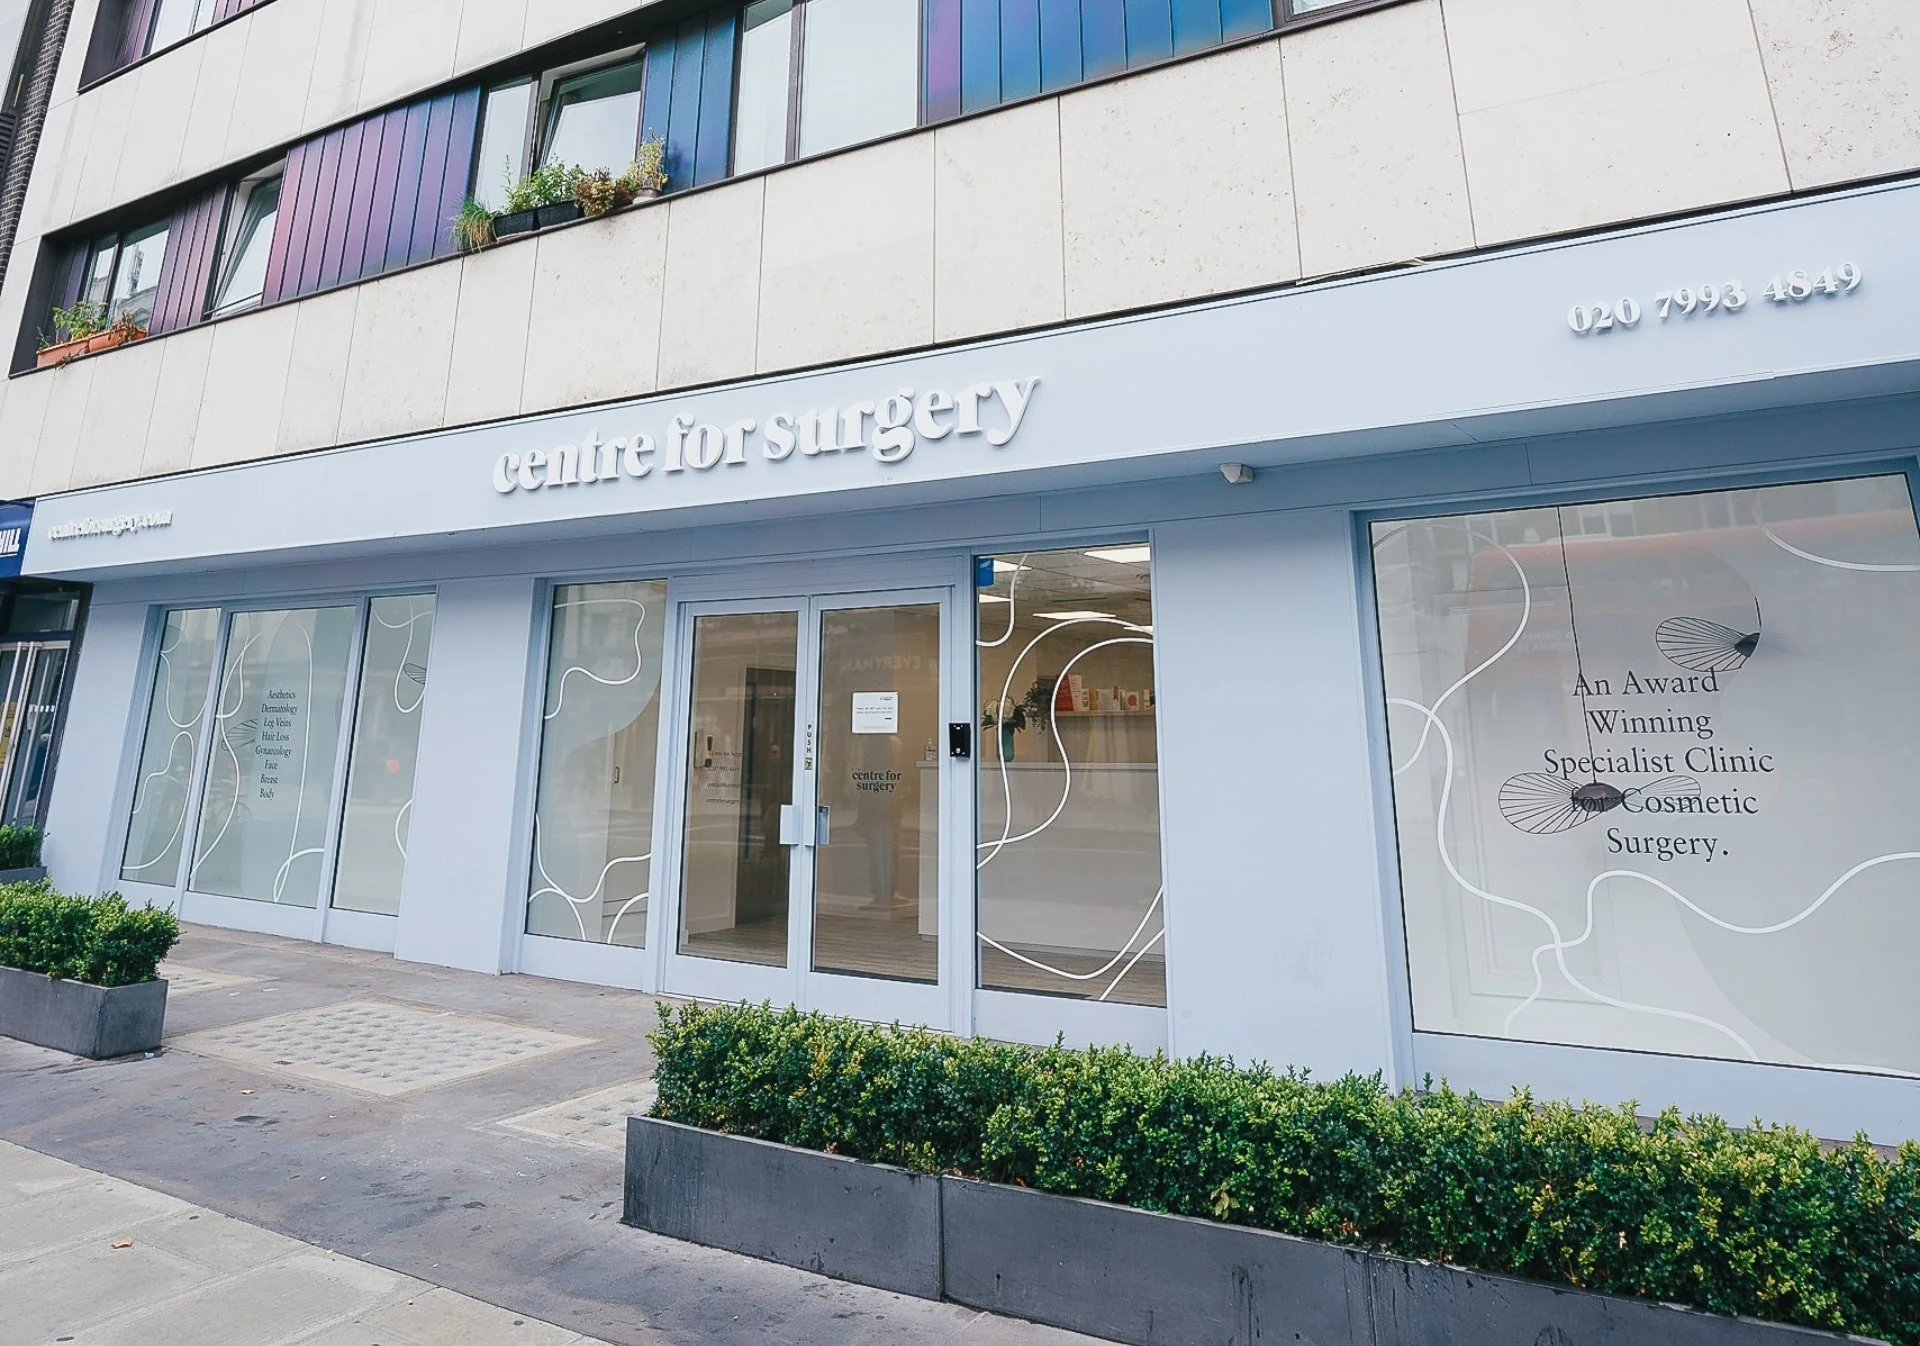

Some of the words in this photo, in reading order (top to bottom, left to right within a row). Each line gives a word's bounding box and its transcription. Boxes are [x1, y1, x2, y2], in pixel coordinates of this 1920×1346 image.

[1567, 297, 1642, 335] 020
[1654, 280, 1748, 320] 7993
[1763, 261, 1863, 302] 4849
[492, 427, 656, 494] centre
[662, 411, 757, 473] for
[763, 374, 1042, 463] surgery
[1571, 672, 1612, 698] An
[1622, 667, 1720, 696] Award
[267, 689, 296, 699] Aesthetics
[261, 703, 298, 715] Dermatology
[263, 717, 274, 729] Leg
[276, 717, 292, 728] Veins
[1587, 709, 1714, 740] Winning
[261, 731, 275, 741] Hair
[276, 731, 290, 742] Loss
[255, 745, 292, 758] Gynaecology
[264, 760, 278, 770] Face
[1544, 747, 1675, 781] Specialist
[1684, 746, 1775, 774] Clinic
[260, 774, 278, 784] Breast
[851, 771, 884, 781] centre
[885, 770, 902, 781] for
[856, 781, 897, 793] surgery
[260, 788, 275, 800] Body
[1570, 786, 1609, 814] for
[1621, 787, 1760, 816] Cosmetic
[1606, 827, 1730, 863] Surgery.
